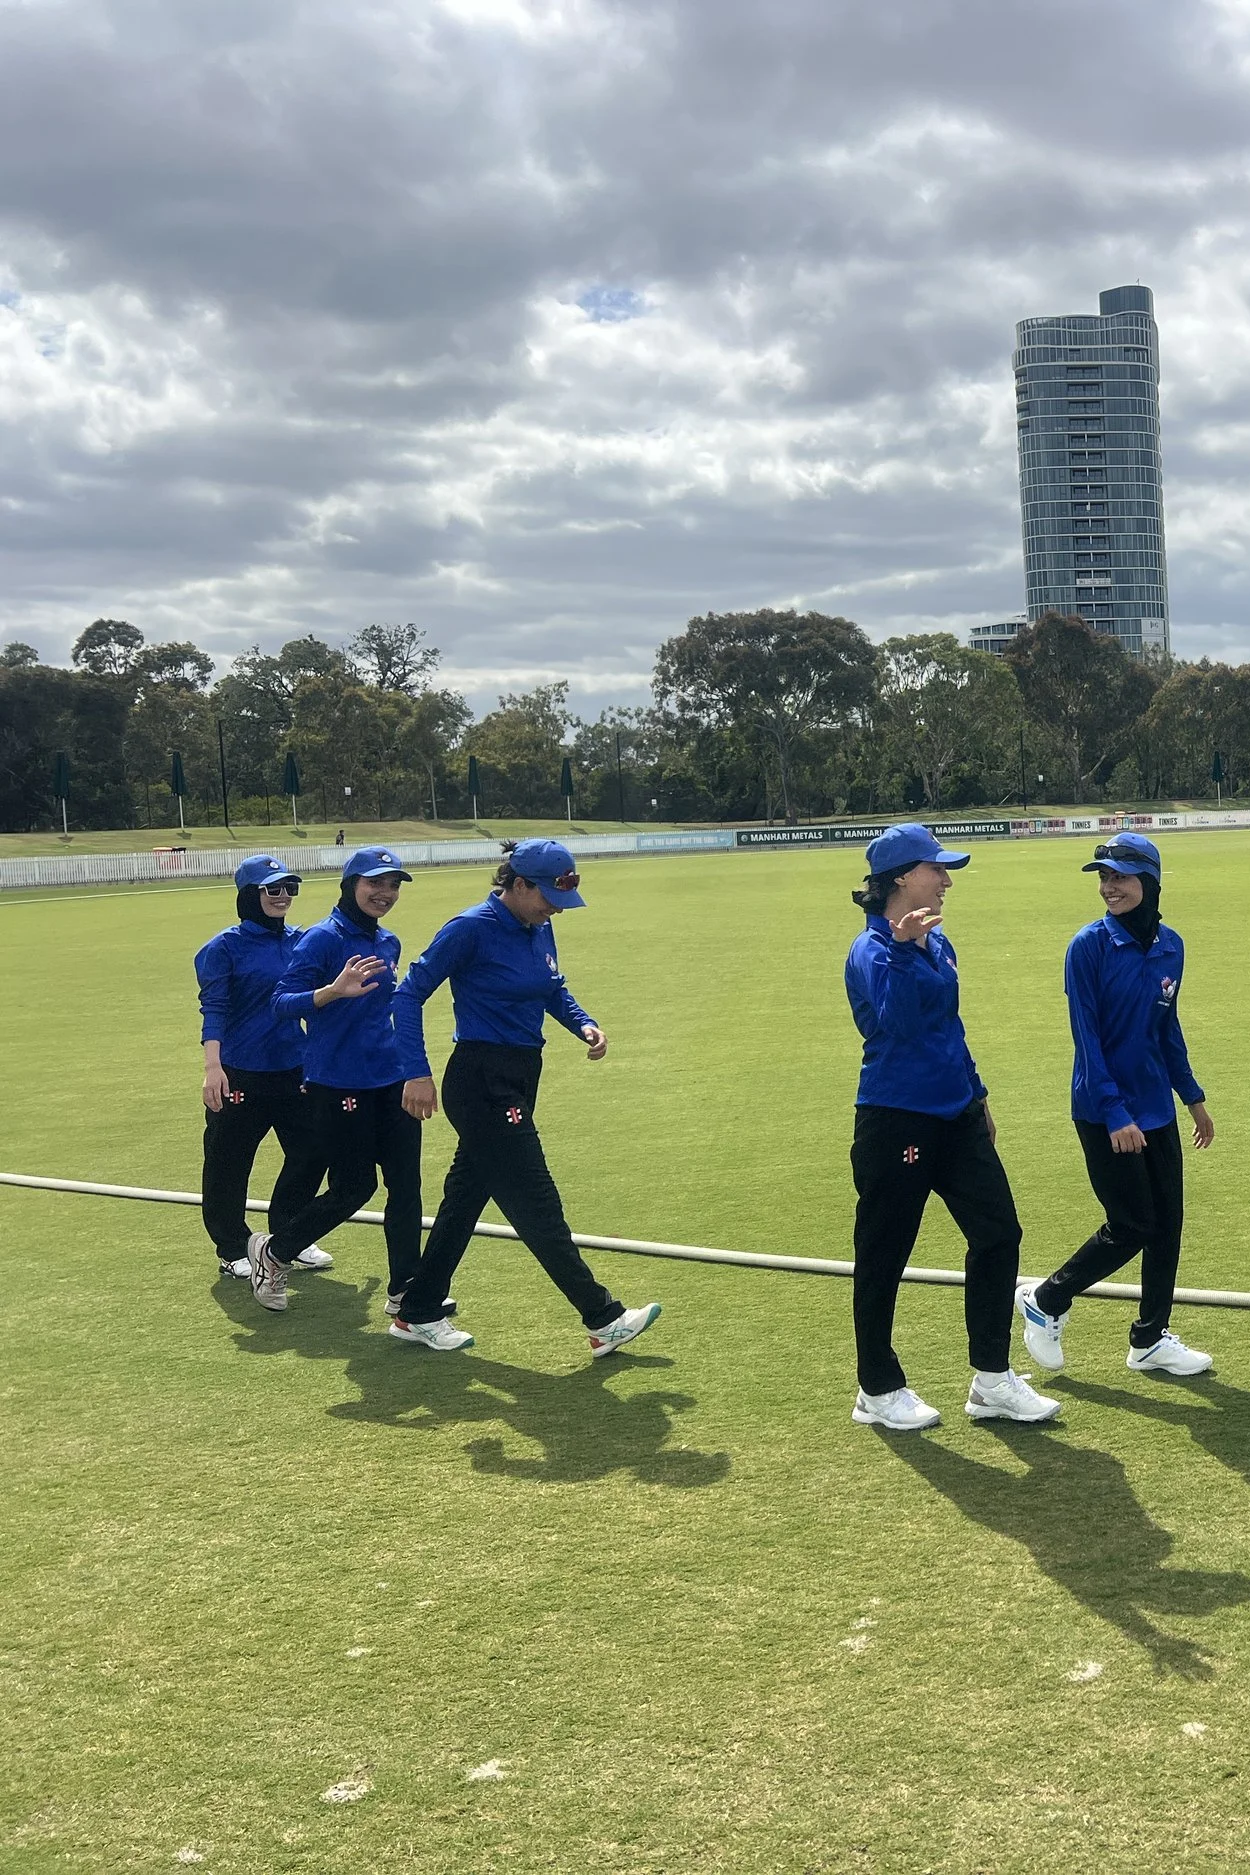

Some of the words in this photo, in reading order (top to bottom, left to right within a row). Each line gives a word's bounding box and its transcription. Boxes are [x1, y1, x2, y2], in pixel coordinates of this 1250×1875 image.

[935, 825, 973, 834] MANHARI
[974, 824, 1004, 832] METALS
[750, 833, 792, 842] MANHARI
[793, 831, 823, 840] METALS
